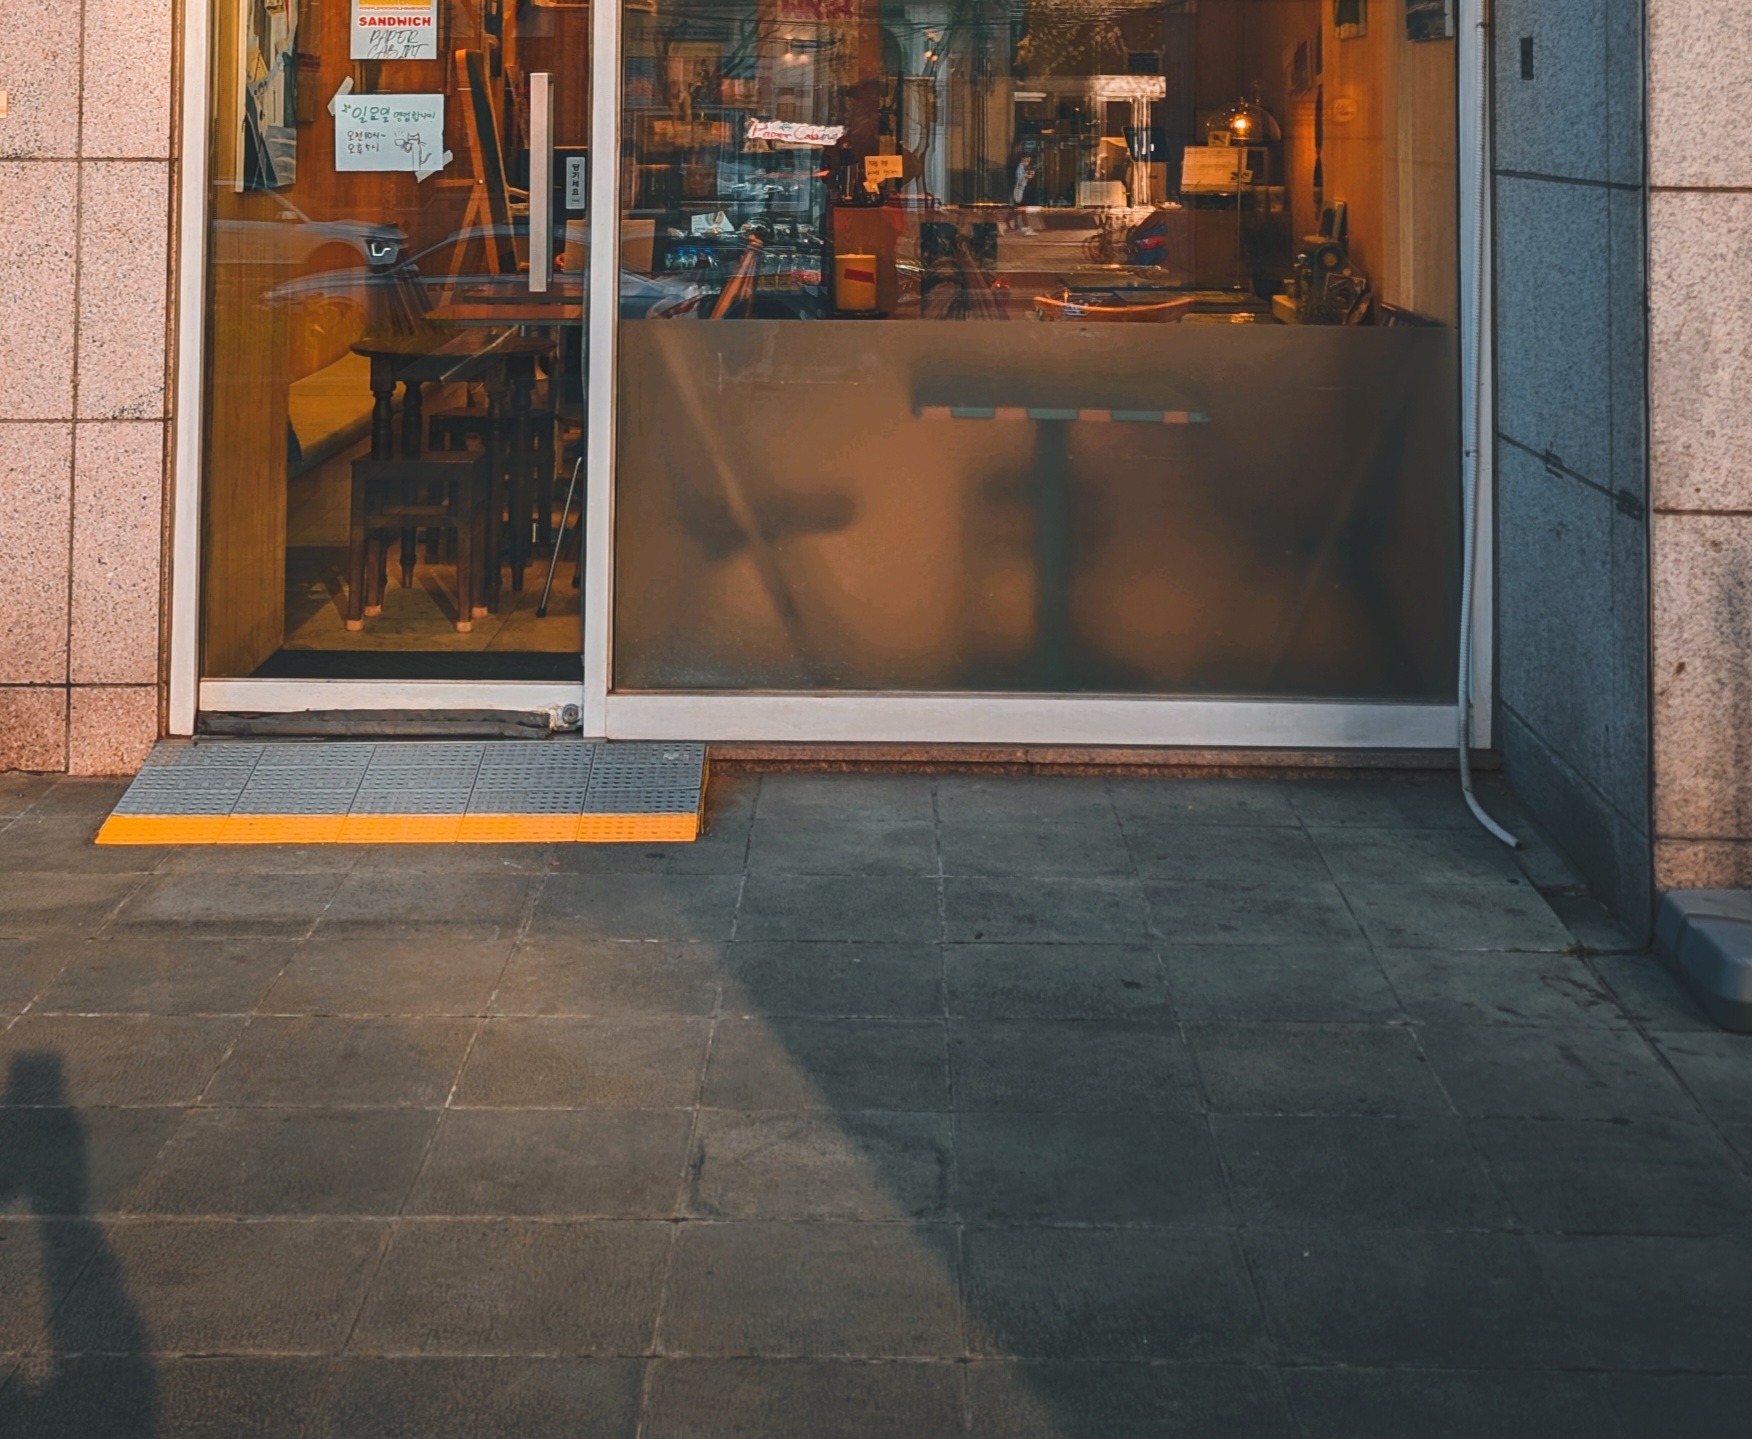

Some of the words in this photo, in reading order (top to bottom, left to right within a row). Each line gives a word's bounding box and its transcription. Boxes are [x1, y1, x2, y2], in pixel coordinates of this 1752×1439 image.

[358, 16, 432, 27] SANDWICH
[351, 106, 391, 123] 일요일
[347, 130, 363, 142] 오전
[347, 143, 363, 155] 오후
